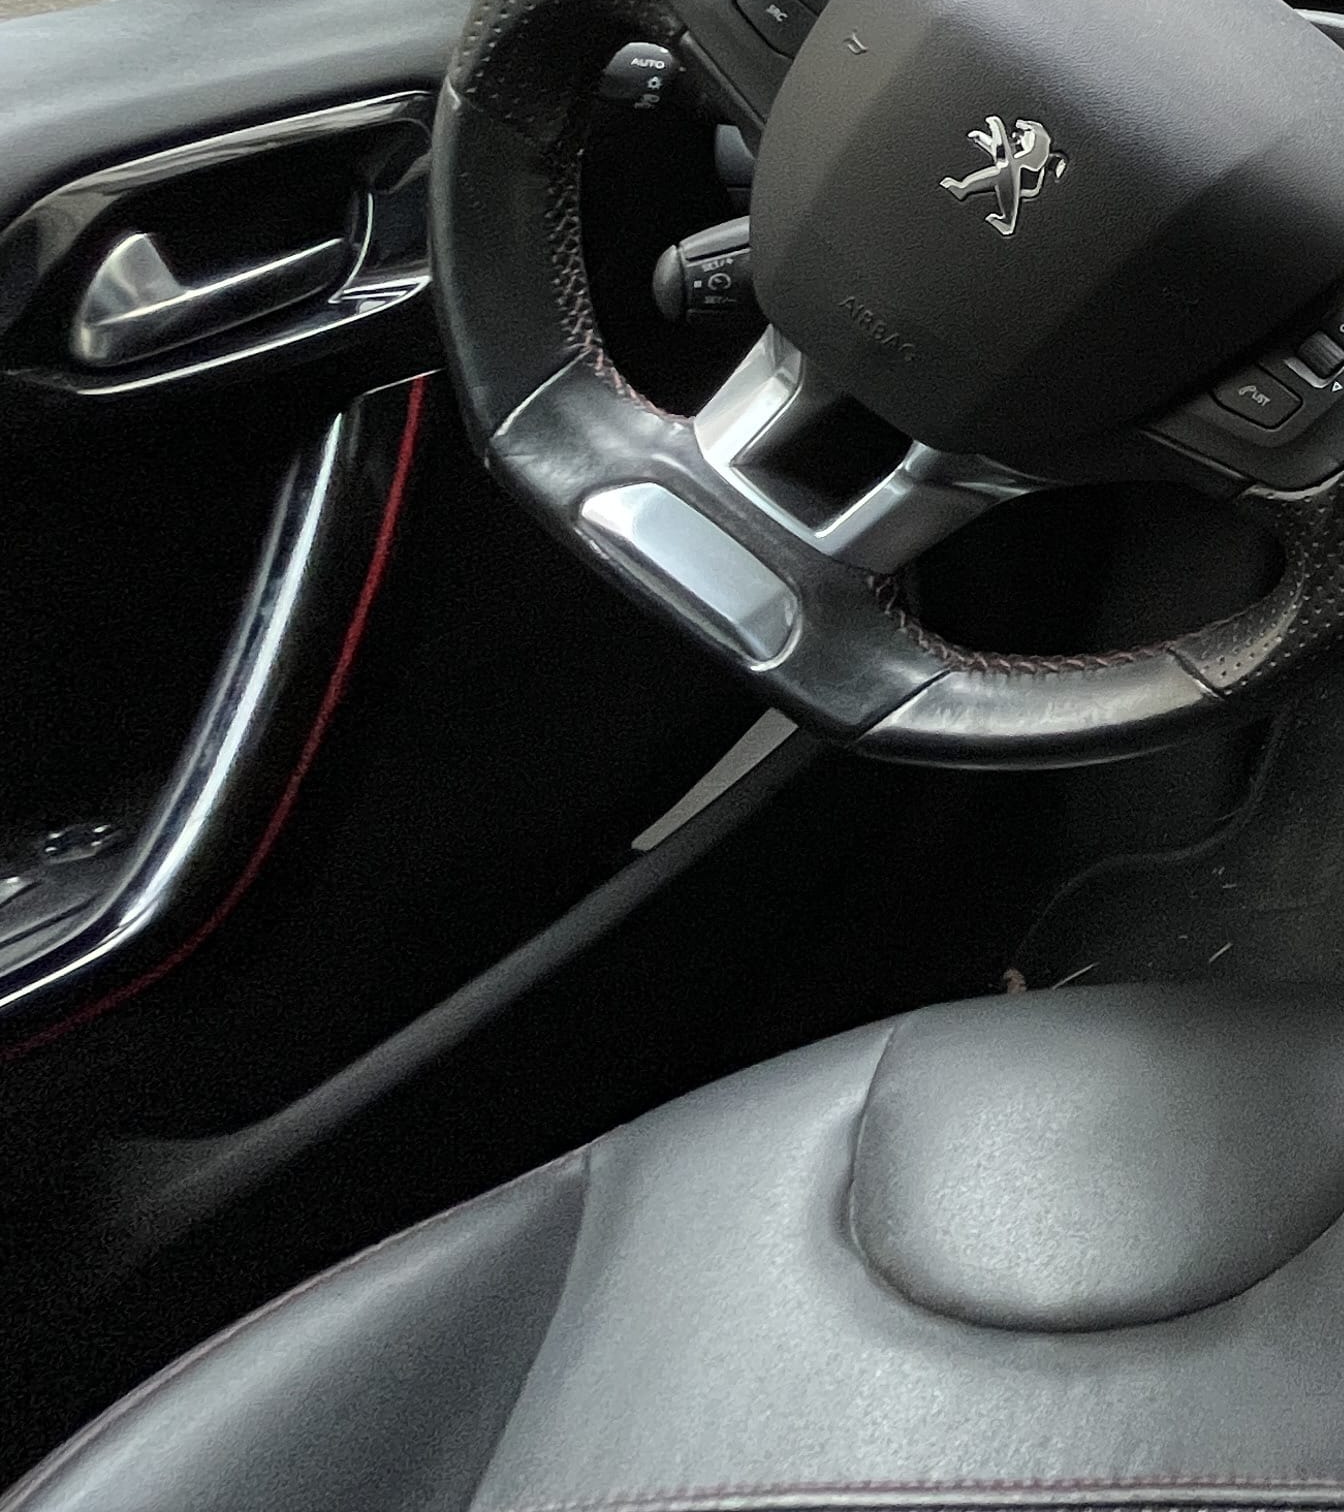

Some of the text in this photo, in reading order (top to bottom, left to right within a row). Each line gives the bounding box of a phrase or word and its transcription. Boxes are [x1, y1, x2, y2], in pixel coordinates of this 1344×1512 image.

[630, 57, 666, 70] AUTO
[837, 295, 915, 362] AIRBAG
[1252, 390, 1271, 407] LIST
